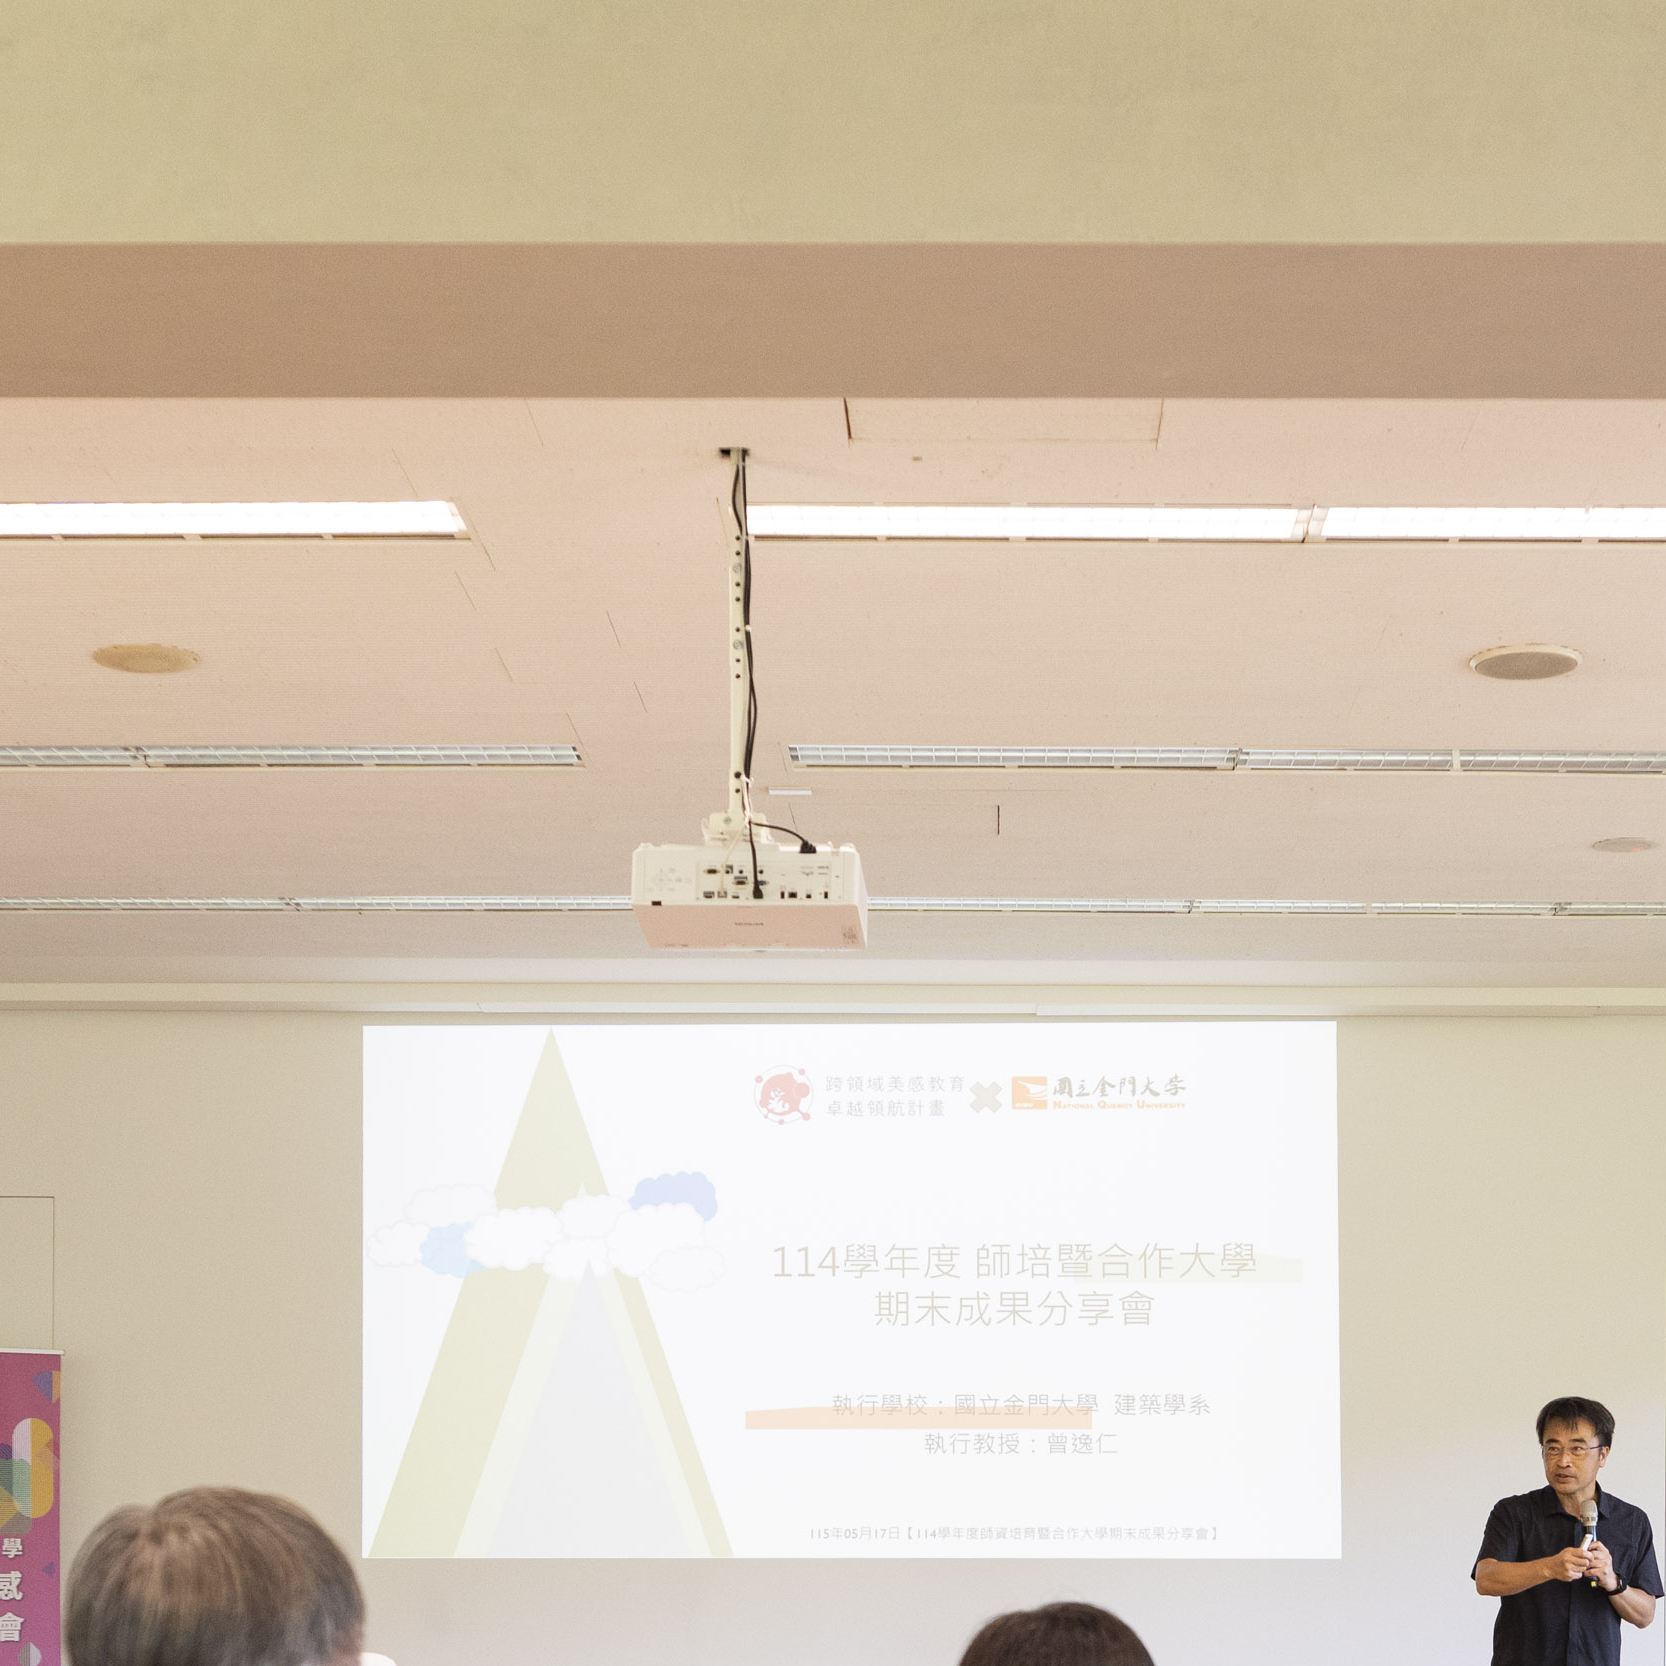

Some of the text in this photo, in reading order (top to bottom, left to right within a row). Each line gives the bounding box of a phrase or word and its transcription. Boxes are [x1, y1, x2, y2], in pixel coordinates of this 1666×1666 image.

[826, 1075, 965, 1094] 跨領域美感教育
[826, 1099, 945, 1118] 卓越領航計畫
[773, 1242, 1258, 1280] 114學年度 師培暨合作大學
[874, 1290, 1156, 1328] 期末成果分享會
[832, 1393, 1212, 1417] 執行學校：國立金門大學 建築學系
[923, 1432, 1119, 1456] 執行教授：曾逸仁
